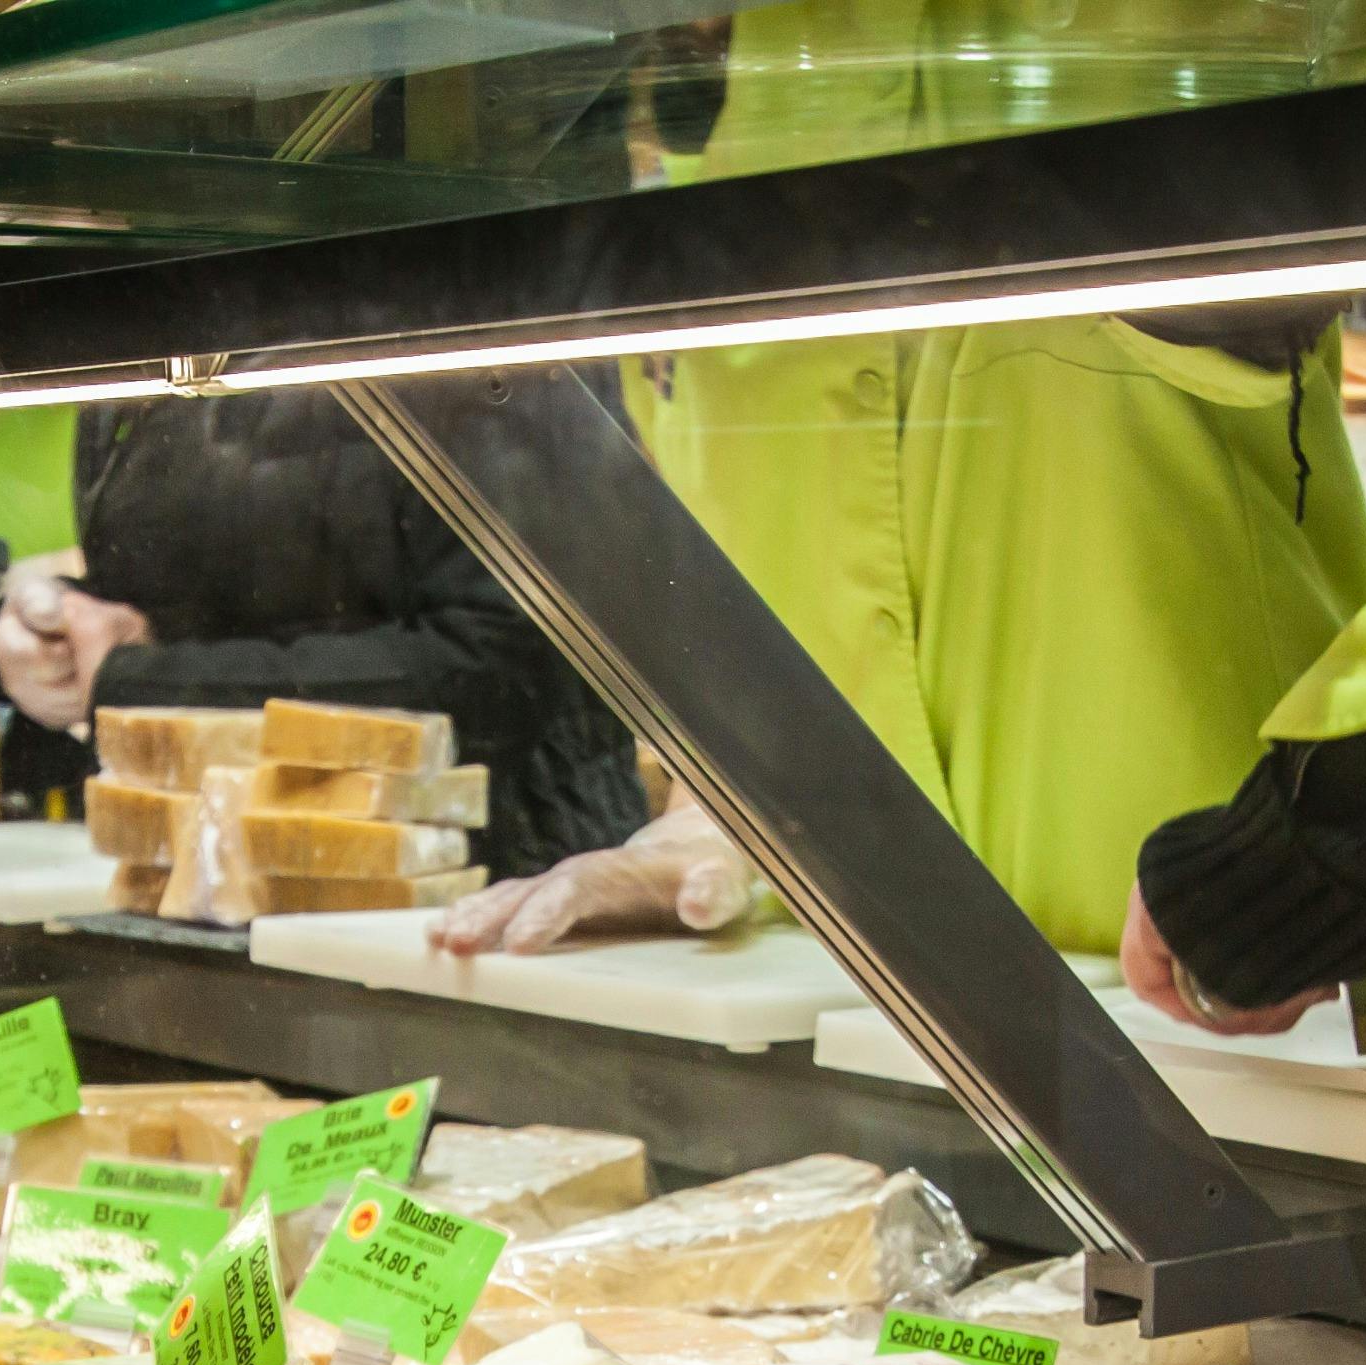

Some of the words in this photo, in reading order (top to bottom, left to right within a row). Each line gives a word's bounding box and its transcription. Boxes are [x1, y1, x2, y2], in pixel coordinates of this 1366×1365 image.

[92, 1201, 151, 1231] Bray
[393, 1198, 463, 1242] Munster
[225, 1256, 245, 1304] Petit
[363, 1241, 410, 1276] 24,80
[412, 1261, 427, 1282] €
[949, 1329, 974, 1352] De
